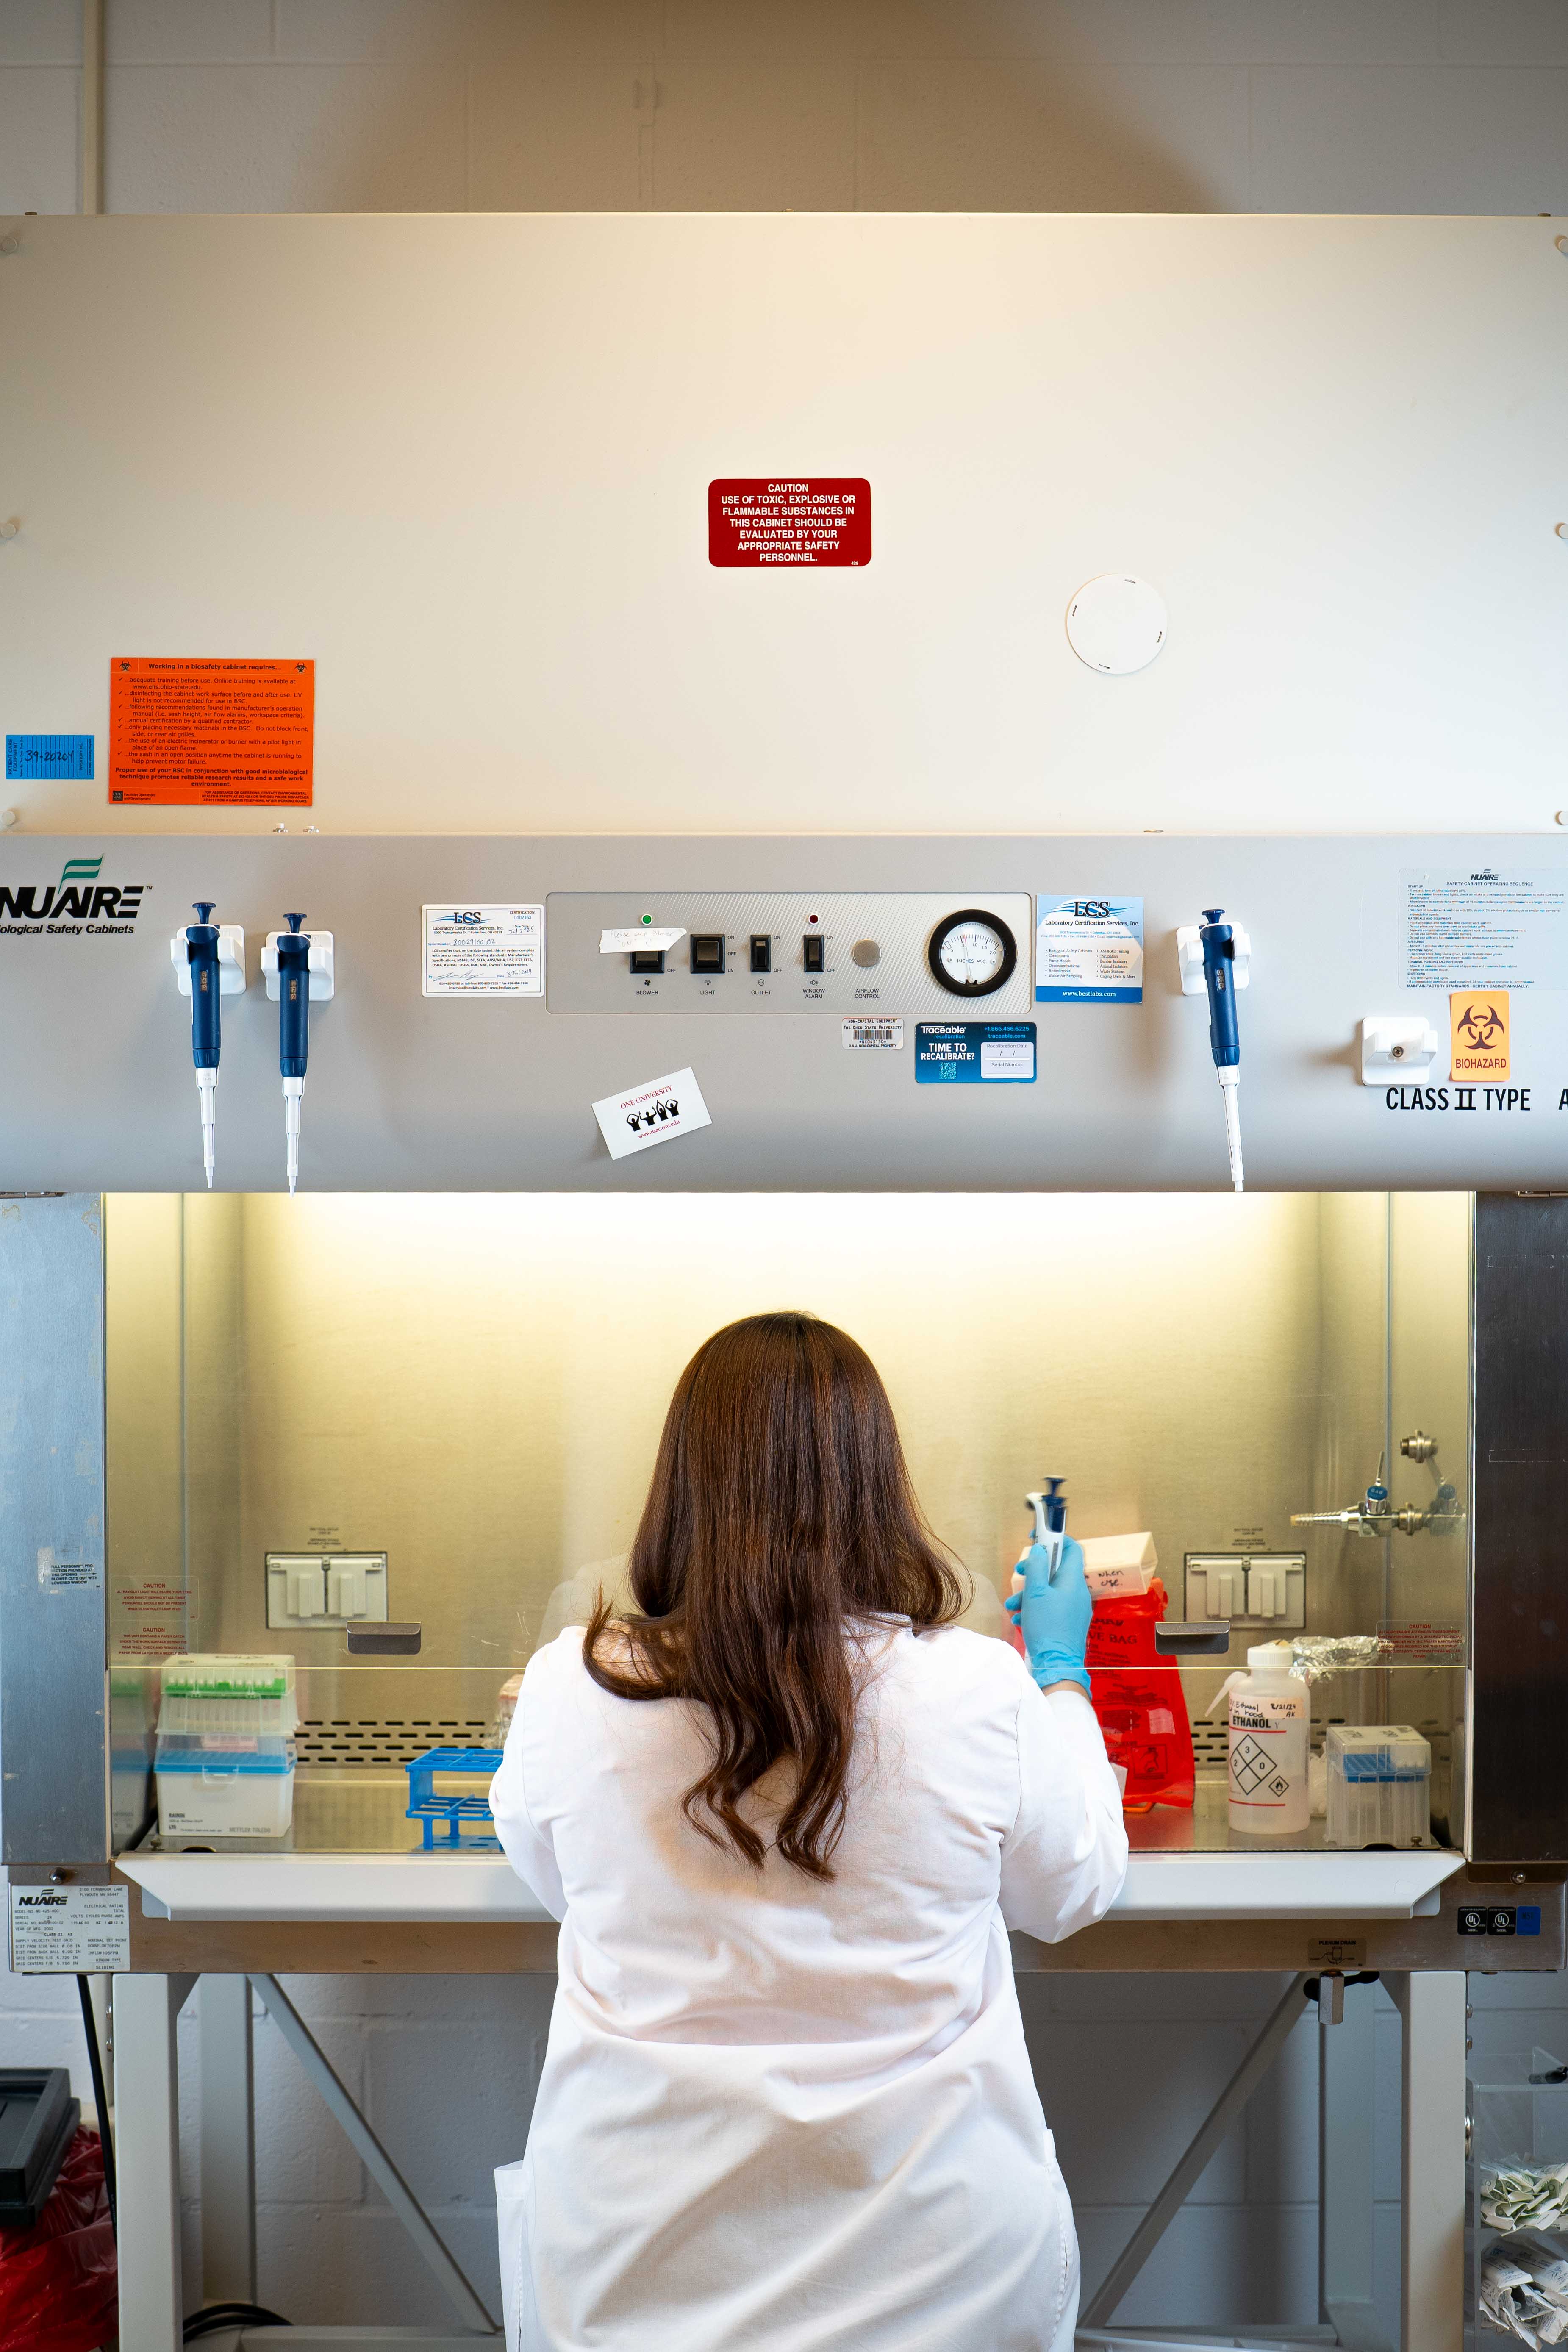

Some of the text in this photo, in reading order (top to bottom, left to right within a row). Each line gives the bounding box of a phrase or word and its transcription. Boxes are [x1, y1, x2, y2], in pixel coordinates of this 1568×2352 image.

[768, 484, 808, 492] CAUTION
[722, 495, 855, 505] USE OF TOXIC, EXPLOSIVE OR
[781, 507, 843, 515] SUBSTANCES
[752, 519, 792, 527] CABINET
[740, 530, 794, 539] EVALUATED
[811, 530, 837, 538] YOUR
[805, 541, 840, 550] SAFETY
[760, 553, 817, 561] PERSONNEL.
[0, 886, 144, 919] NUAIRE
[1074, 901, 1109, 917] LCS
[454, 912, 481, 924] LCS
[0, 924, 133, 935] ological Safety Cabinets
[921, 1026, 965, 1034] Traceable
[929, 1043, 967, 1052] TIME TO
[1456, 1058, 1506, 1068] BIOHAZARD
[620, 1085, 672, 1109] ONE UNIVERSITY
[1386, 1087, 1449, 1110] CLASS
[1454, 1088, 1476, 1110] II
[1483, 1089, 1531, 1111] TYPE
[638, 1119, 680, 1139] www.usac.osu.edu
[1110, 1634, 1137, 1644] BAG
[1233, 1716, 1271, 1728] ETHANOL
[19, 1896, 68, 1905] NUAIRE
[1469, 1916, 1476, 1924] UL
[1498, 1916, 1505, 1924] UL
